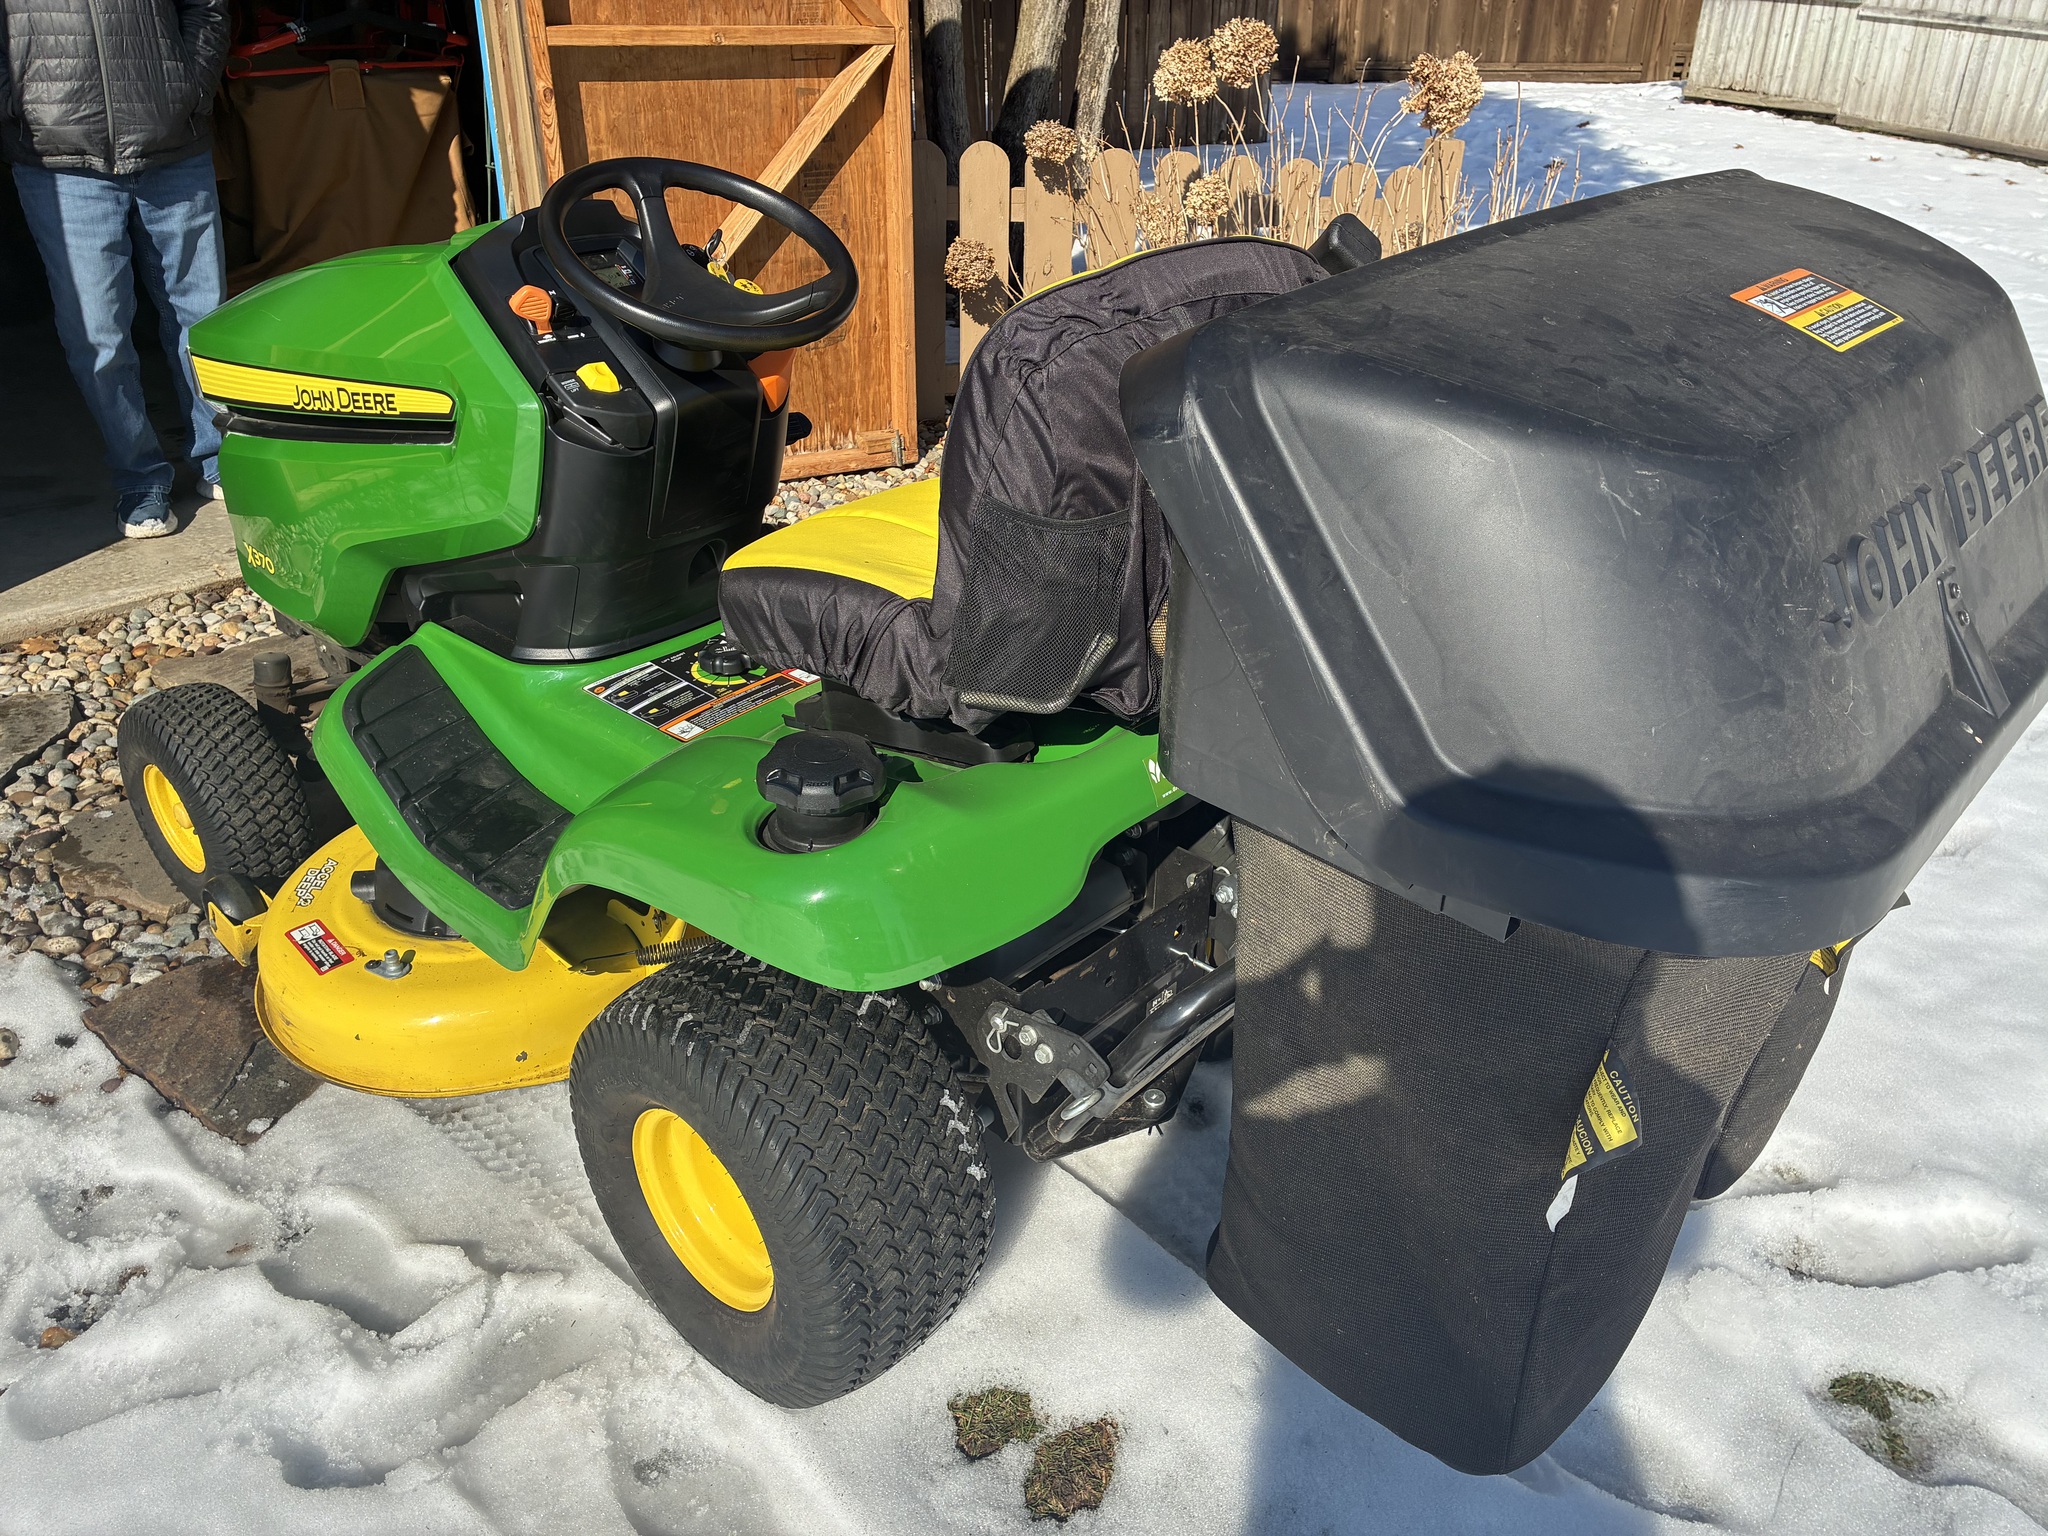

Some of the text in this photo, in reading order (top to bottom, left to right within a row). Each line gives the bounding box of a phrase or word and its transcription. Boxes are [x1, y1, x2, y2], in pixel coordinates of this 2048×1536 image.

[293, 384, 398, 412] JOHN DEERE
[242, 541, 275, 576] X370
[1819, 483, 1948, 652] JOHN
[294, 868, 320, 898] DEEP
[308, 857, 339, 892] ACCEL
[1609, 1070, 1640, 1123] CAUTION
[1617, 1105, 1627, 1118] AND
[1602, 1127, 1613, 1142] WITH
[1606, 1109, 1623, 1134] REPLACE
